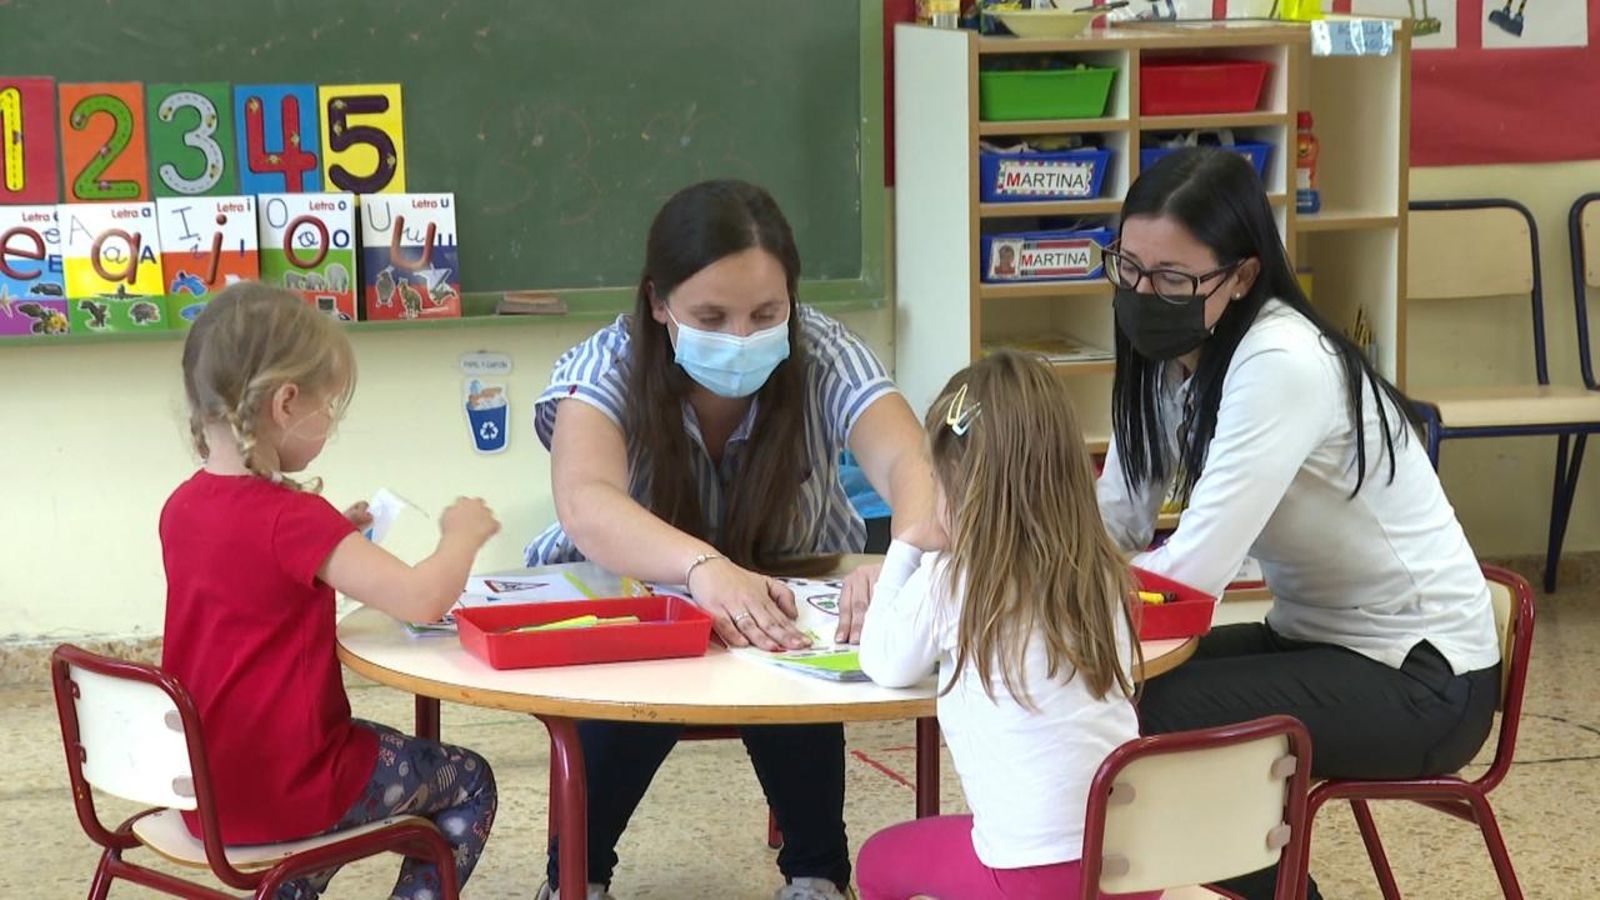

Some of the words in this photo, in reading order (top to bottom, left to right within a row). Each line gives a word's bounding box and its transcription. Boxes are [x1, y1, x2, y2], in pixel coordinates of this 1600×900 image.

[0, 86, 24, 192] 1
[70, 94, 140, 200] 2
[157, 91, 225, 195] 3
[244, 94, 317, 193] 4
[327, 94, 397, 194] 5
[1006, 172, 1085, 188] MARTINA
[22, 211, 50, 223] Letra
[111, 208, 139, 219] Letra
[141, 207, 152, 218] a
[216, 202, 244, 213] Letra
[246, 198, 251, 211] i
[309, 200, 336, 211] Letra
[338, 199, 347, 211] o
[367, 201, 392, 232] U
[412, 198, 438, 209] Letra
[69, 214, 94, 246] A
[171, 206, 200, 241] I
[332, 229, 350, 248] O
[0, 226, 46, 281] e
[91, 228, 142, 285] a
[140, 245, 157, 264] A
[208, 213, 228, 285] i
[283, 214, 330, 269] o
[1021, 251, 1089, 267] MARTINA
